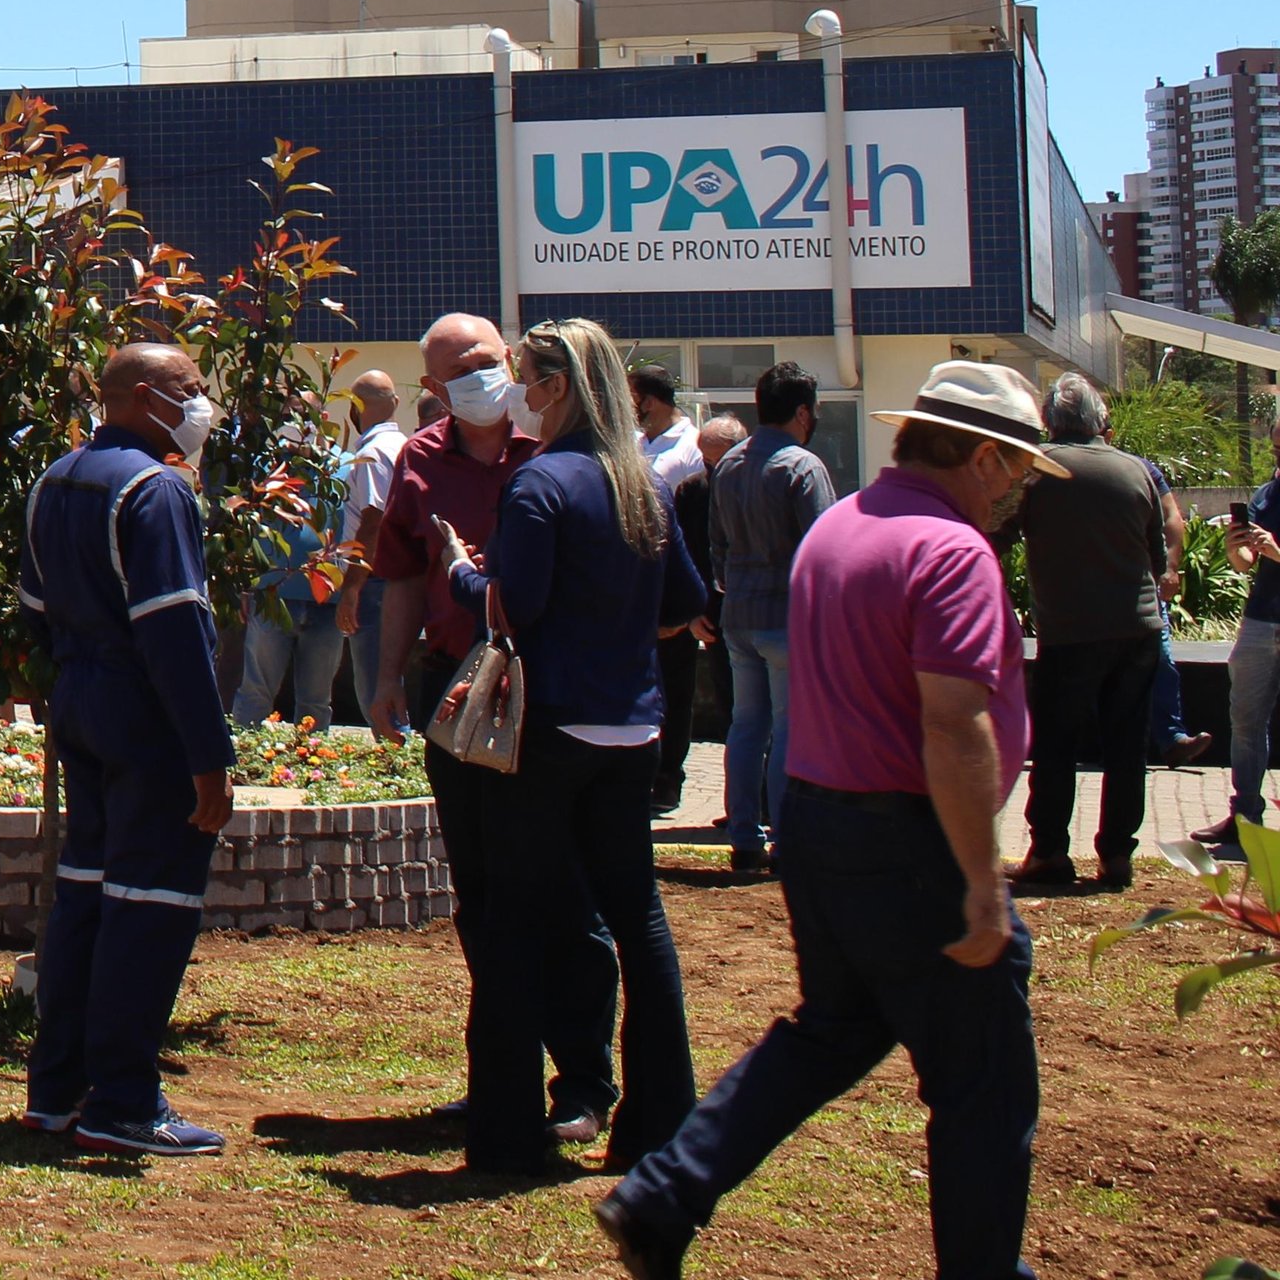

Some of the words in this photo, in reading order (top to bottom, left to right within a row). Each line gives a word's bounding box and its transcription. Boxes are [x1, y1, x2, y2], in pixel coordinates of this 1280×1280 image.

[533, 148, 760, 235] UPA
[534, 241, 630, 264] UNIDADE
[637, 241, 665, 262] DE
[672, 238, 760, 261] PRONTO
[765, 235, 926, 260] ATENDMENTO
